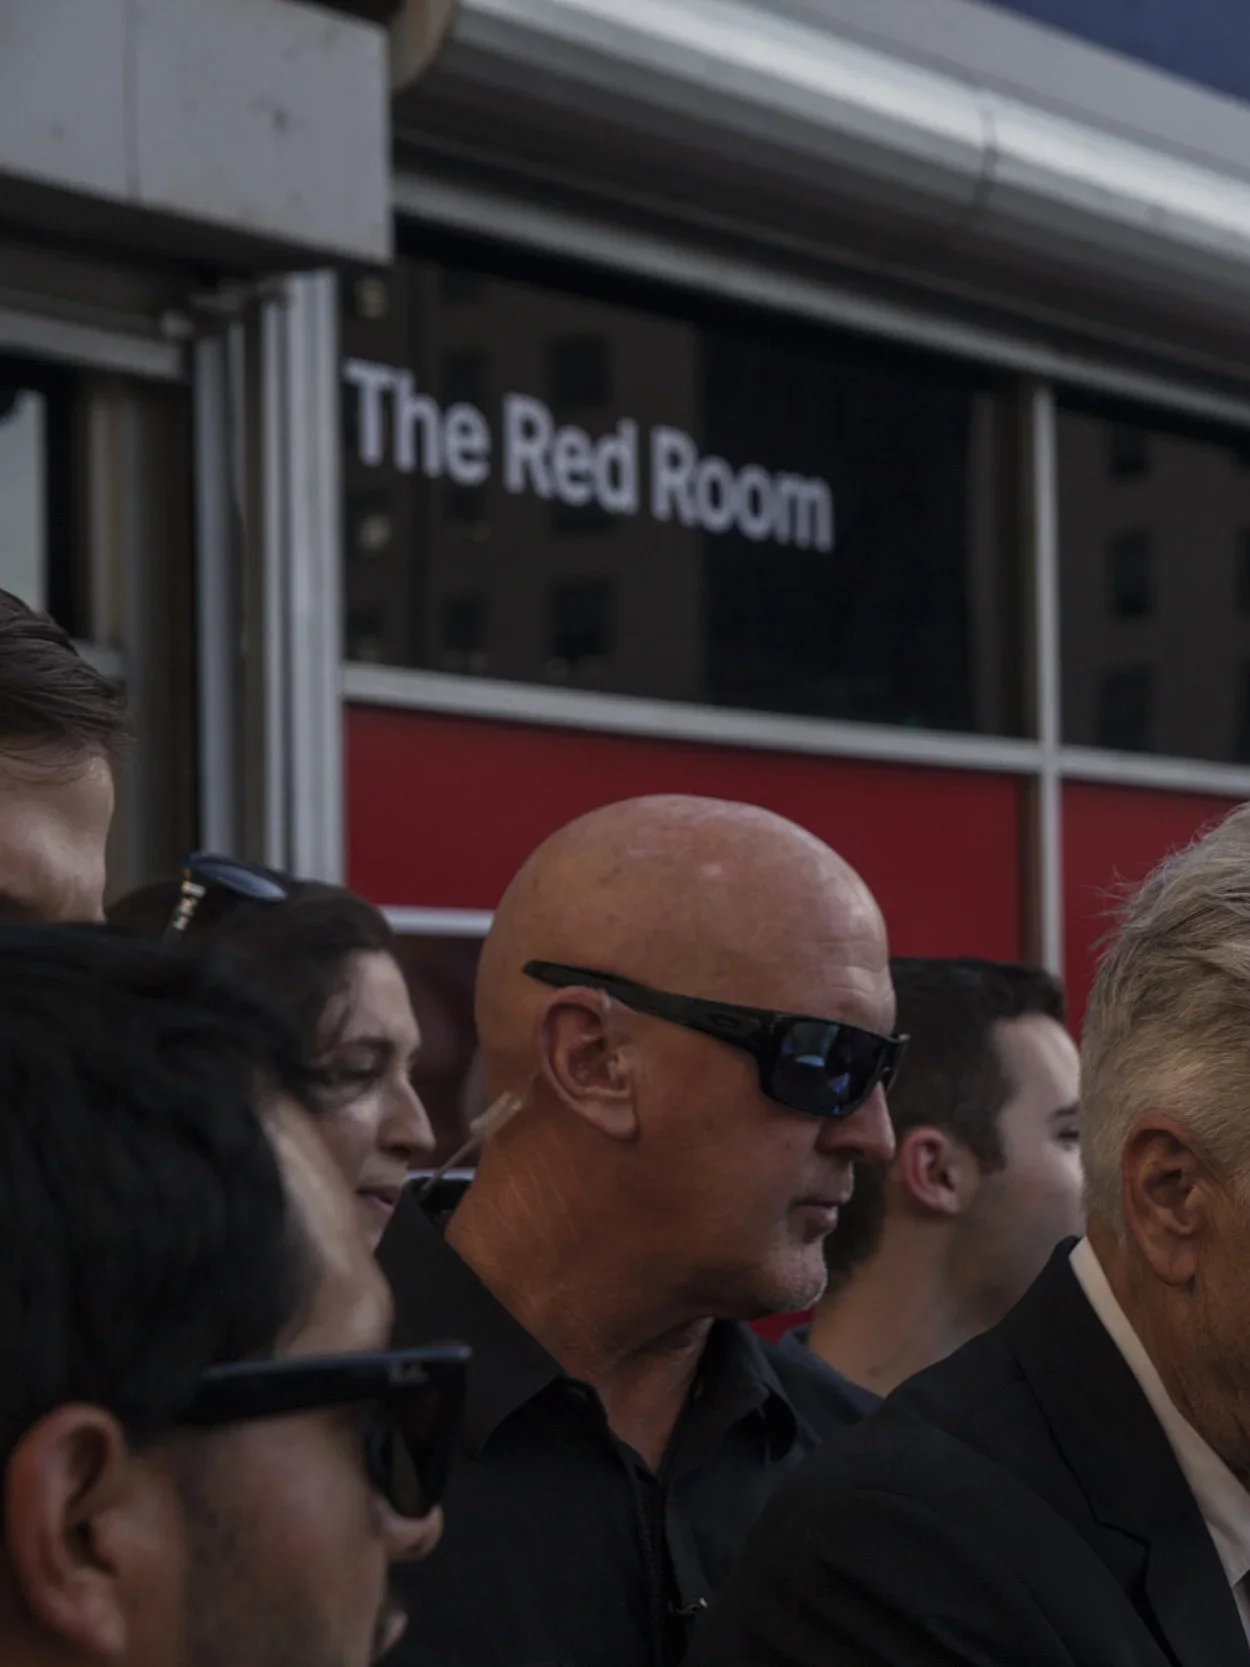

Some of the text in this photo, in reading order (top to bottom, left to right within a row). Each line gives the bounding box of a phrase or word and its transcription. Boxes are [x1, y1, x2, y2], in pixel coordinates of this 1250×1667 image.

[342, 357, 834, 554] The Red Room
